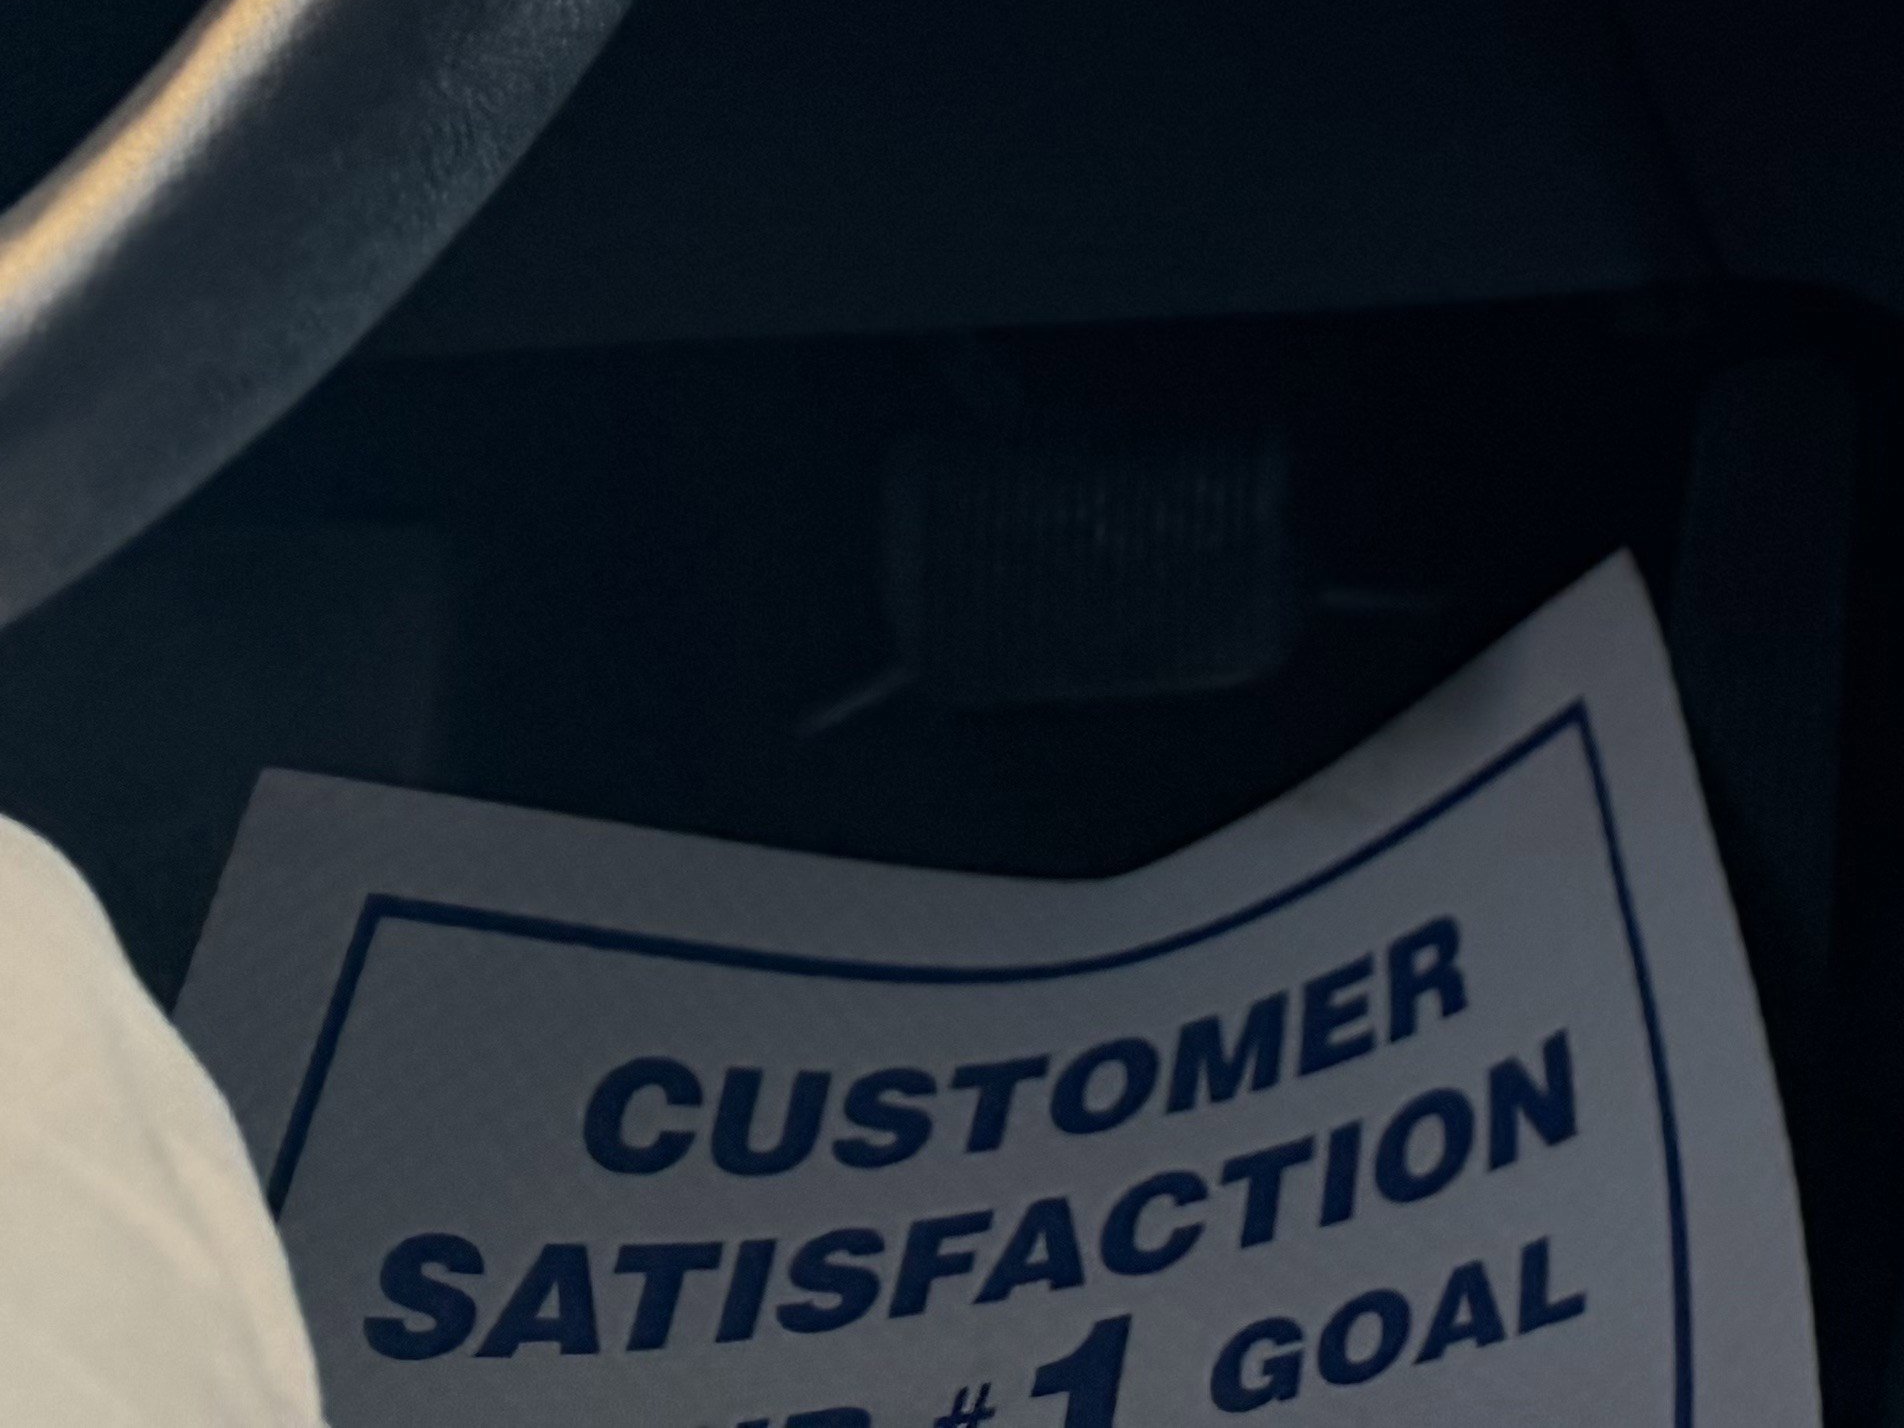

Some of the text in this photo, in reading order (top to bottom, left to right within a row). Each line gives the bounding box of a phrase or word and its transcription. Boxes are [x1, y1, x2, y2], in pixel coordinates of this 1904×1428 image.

[581, 912, 1471, 1180] CUSTOMER
[361, 1026, 1584, 1364] SATISFACTION
[1207, 1233, 1591, 1419] GOAL
